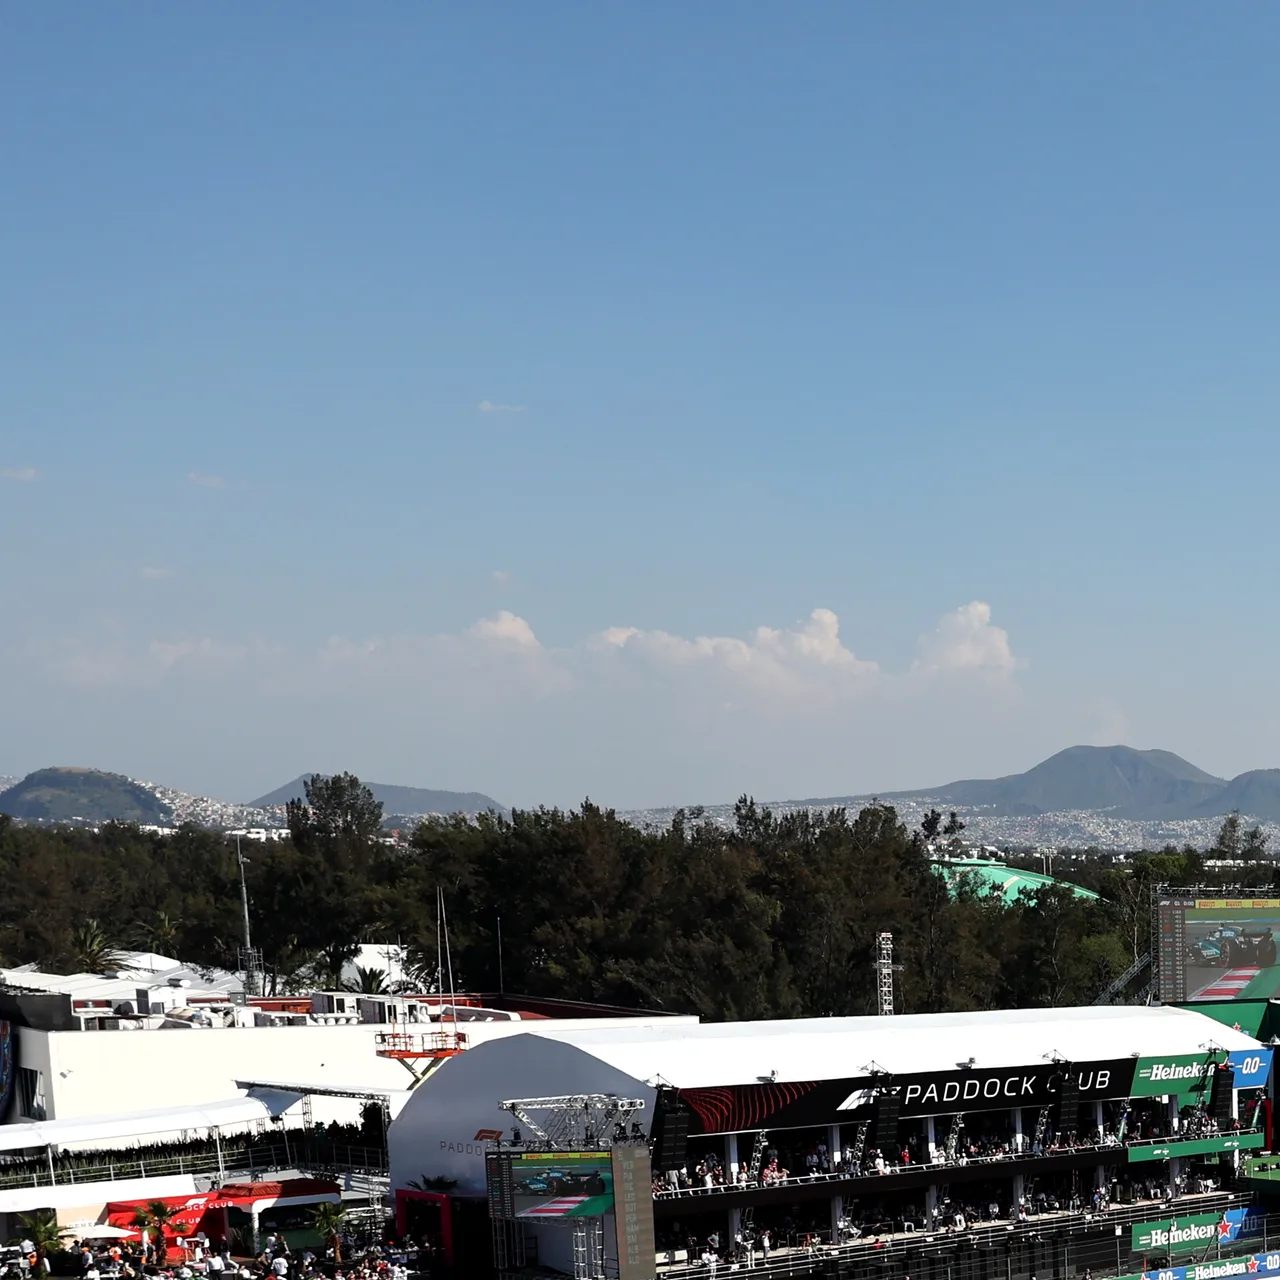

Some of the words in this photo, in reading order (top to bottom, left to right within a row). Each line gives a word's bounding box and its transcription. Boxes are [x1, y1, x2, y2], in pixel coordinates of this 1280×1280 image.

[905, 1075, 1036, 1105] PADDOCK
[1047, 1070, 1110, 1092] CUB
[1194, 1258, 1246, 1280] Heineken
